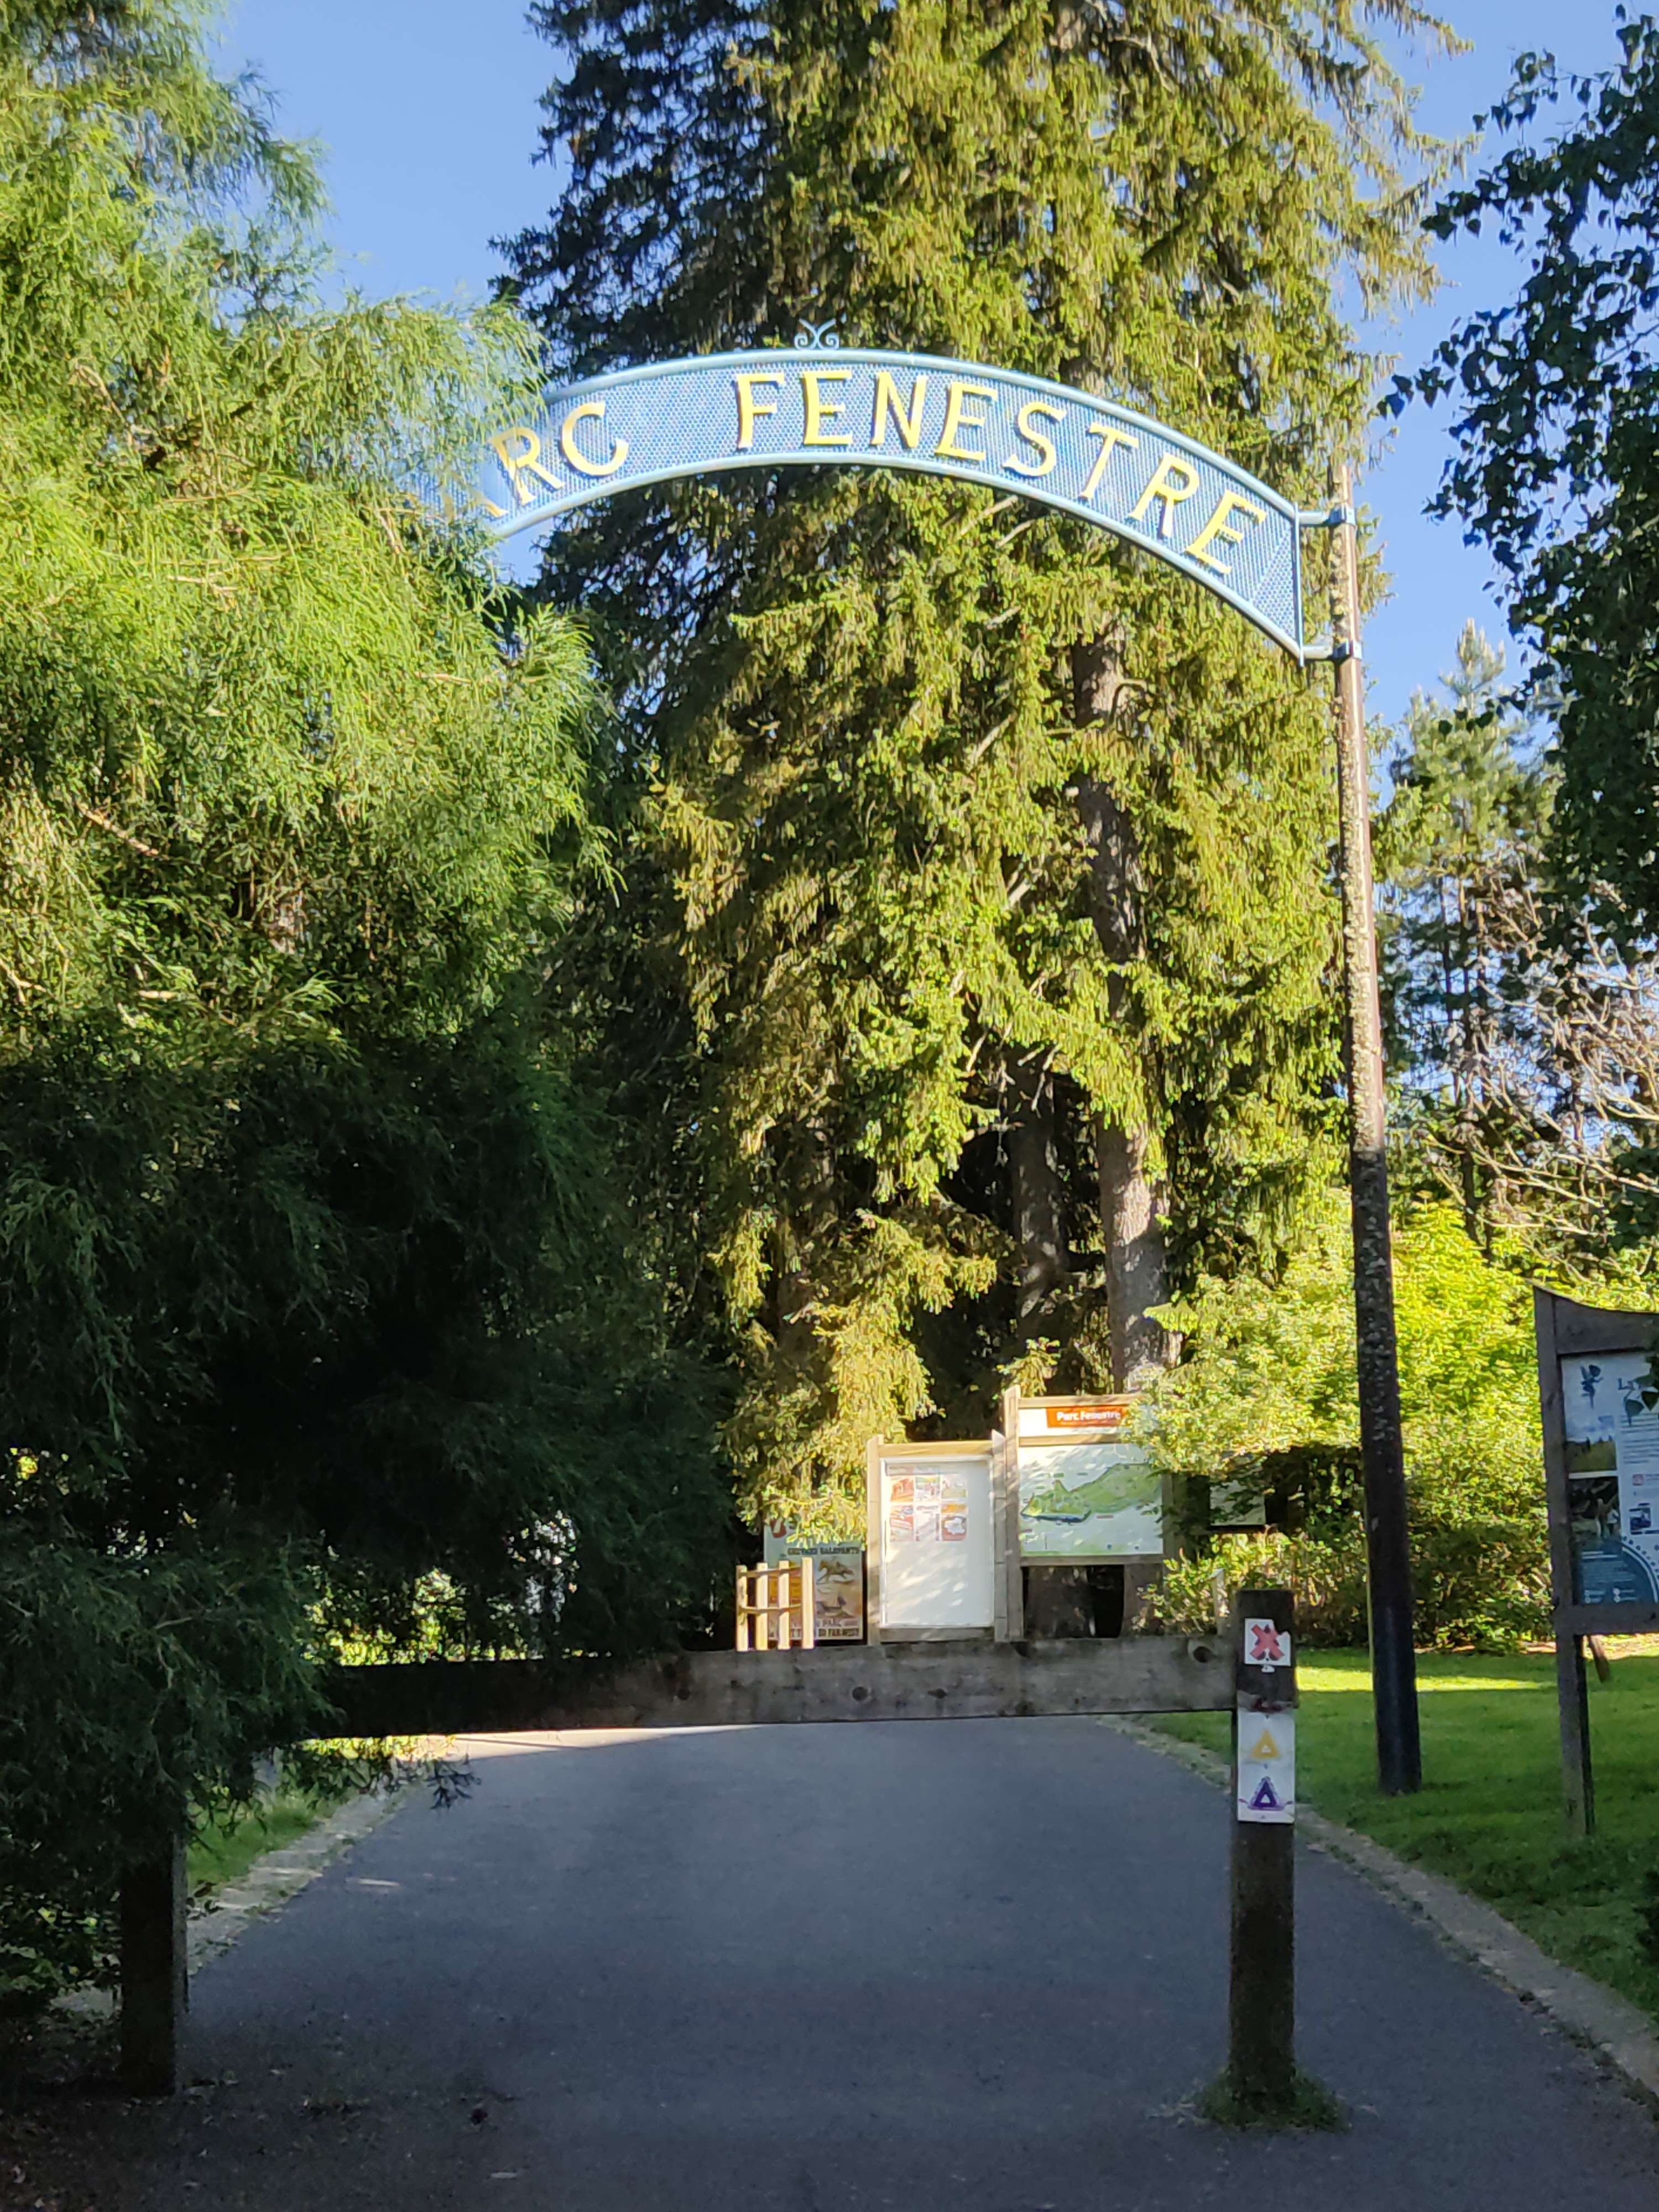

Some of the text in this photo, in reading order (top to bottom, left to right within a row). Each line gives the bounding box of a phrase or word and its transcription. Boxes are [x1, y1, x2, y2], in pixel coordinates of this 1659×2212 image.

[735, 369, 1267, 575] FENESTRE
[1056, 1410, 1121, 1421] Parc Fenestre
